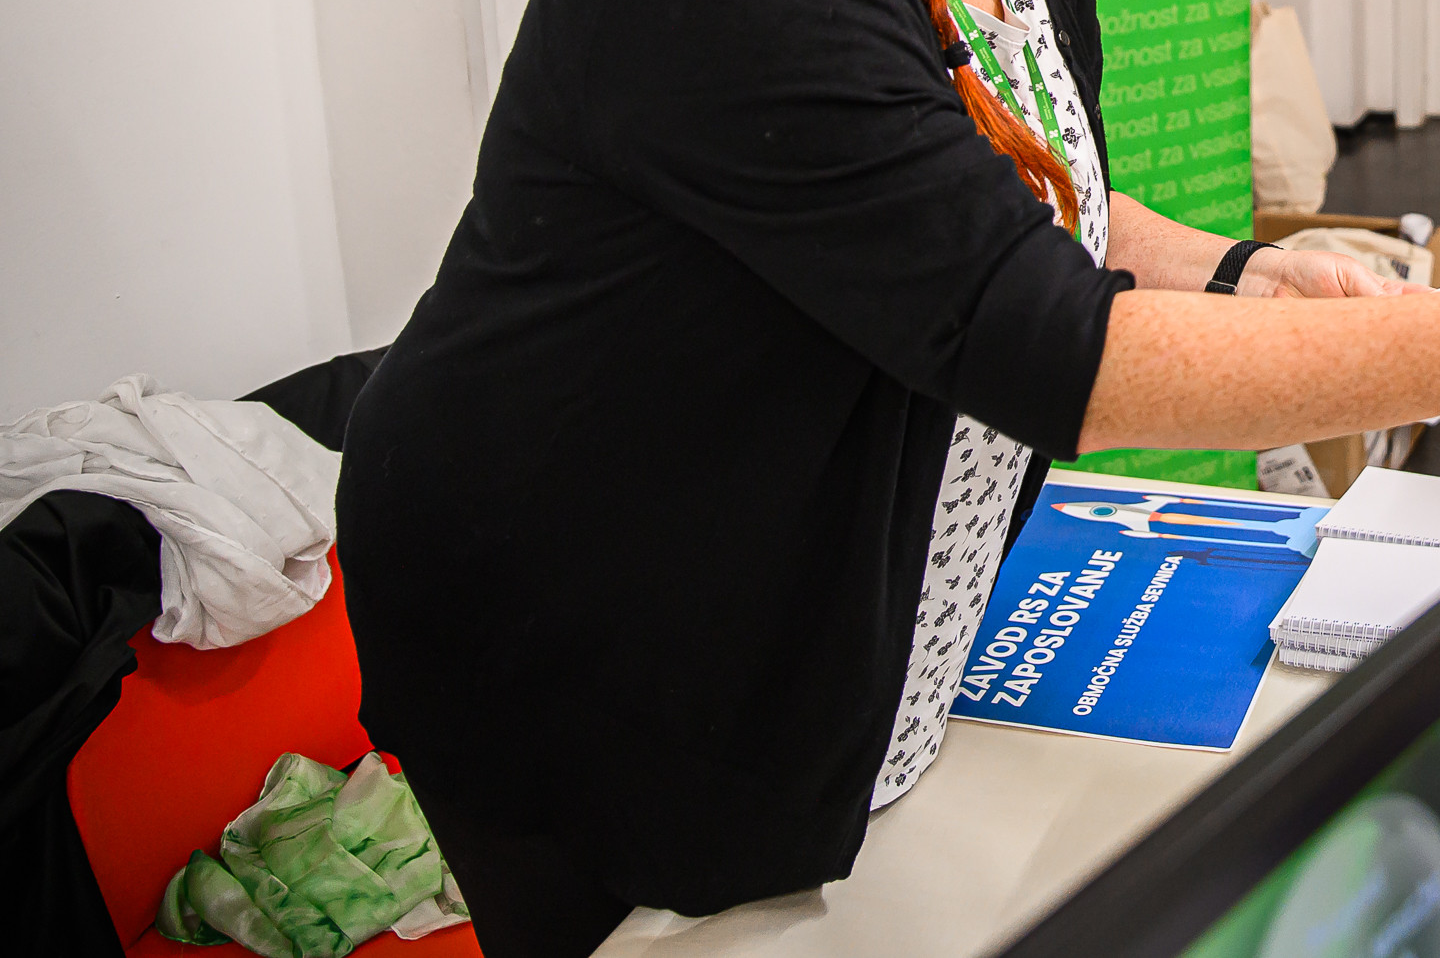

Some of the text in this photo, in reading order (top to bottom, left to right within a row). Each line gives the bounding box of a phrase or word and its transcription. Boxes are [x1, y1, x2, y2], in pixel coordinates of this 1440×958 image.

[1185, 2, 1211, 23] za
[1103, 39, 1172, 72] ožnost
[1179, 38, 1203, 60] za
[1172, 74, 1197, 96] za
[1165, 109, 1190, 132] za
[1158, 145, 1184, 167] za
[1152, 180, 1177, 201] za
[957, 571, 1071, 702] ZAVOD RS ZA
[991, 549, 1123, 707] ZAPOSLOVANJE
[1073, 555, 1183, 716] OBMOČNA SLUŽBA SEVNICA
